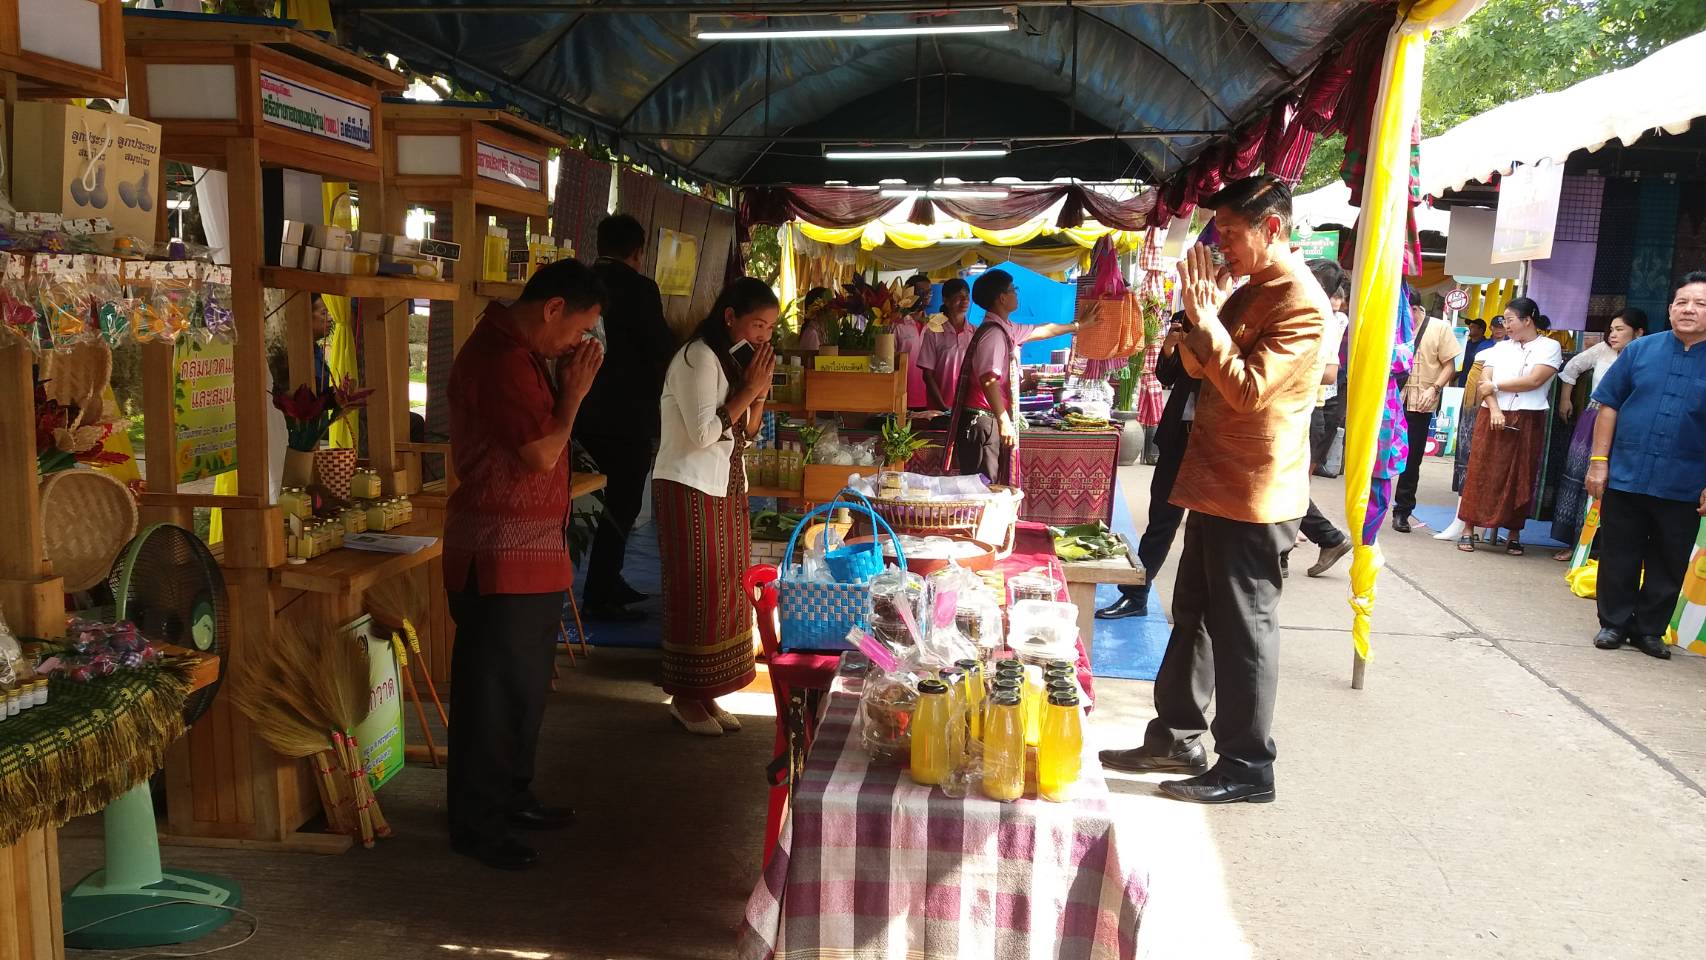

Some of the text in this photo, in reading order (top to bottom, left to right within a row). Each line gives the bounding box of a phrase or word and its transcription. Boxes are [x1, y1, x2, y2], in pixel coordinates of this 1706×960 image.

[263, 94, 324, 133] ครือข่ายกองทุนหมู่บ้าน
[117, 136, 157, 154] ลูกประคบ
[124, 152, 151, 166] สมุนไพร
[180, 354, 234, 386] กลุ่มนวดแ
[368, 677, 395, 713] กวาด
